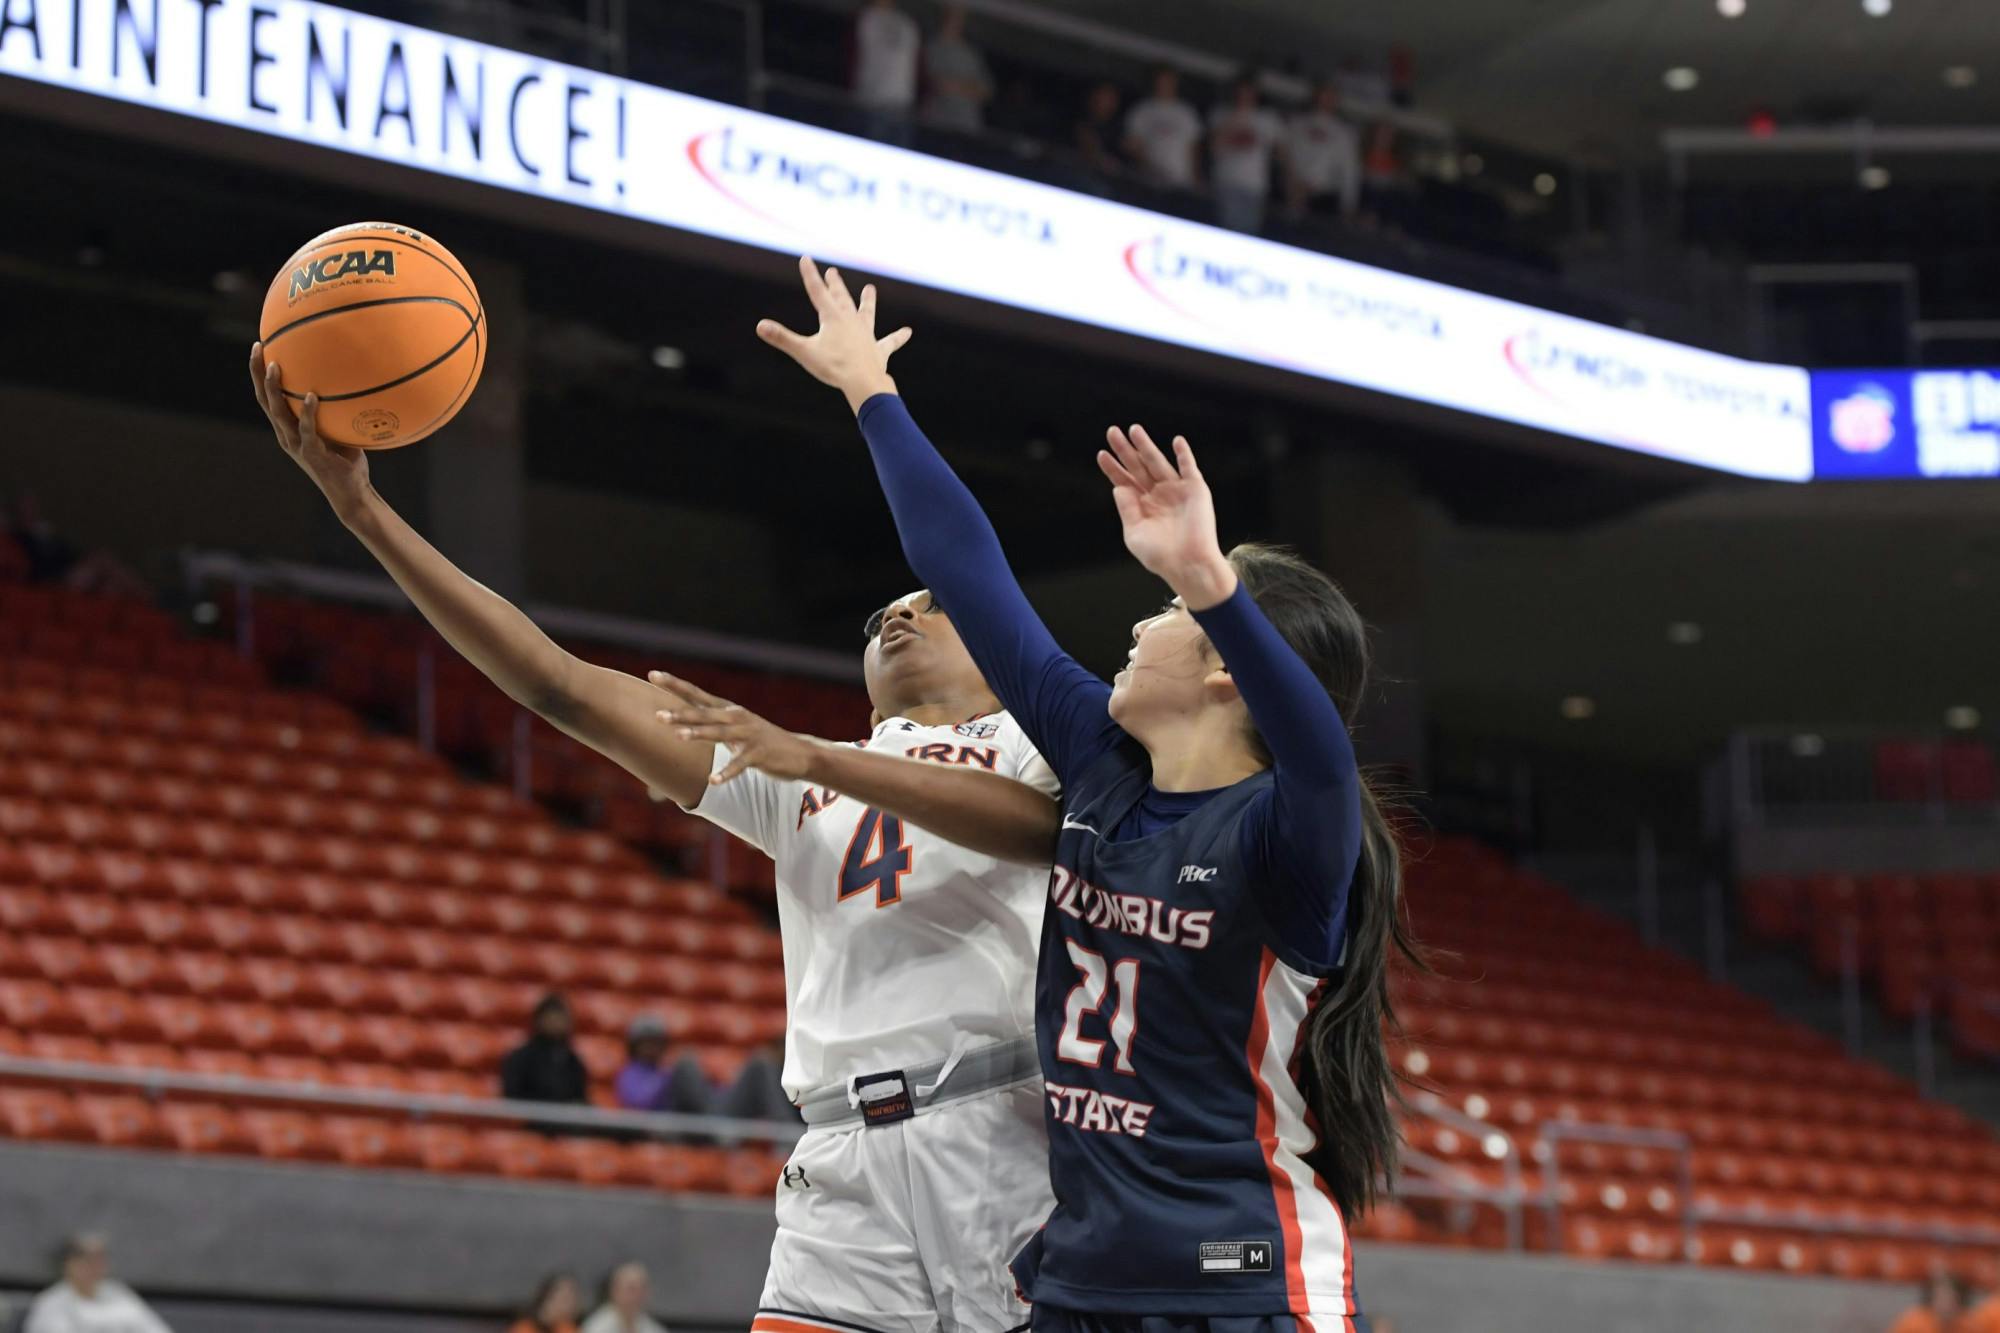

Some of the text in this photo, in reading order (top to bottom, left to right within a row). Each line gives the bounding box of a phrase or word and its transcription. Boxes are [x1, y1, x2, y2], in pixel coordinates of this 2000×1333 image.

[718, 125, 878, 202] LYNCH
[288, 250, 396, 299] NCAA
[838, 803, 912, 908] 4
[1058, 937, 1141, 1075] 21
[1045, 1081, 1155, 1137] STATE
[1250, 1250, 1263, 1263] M
